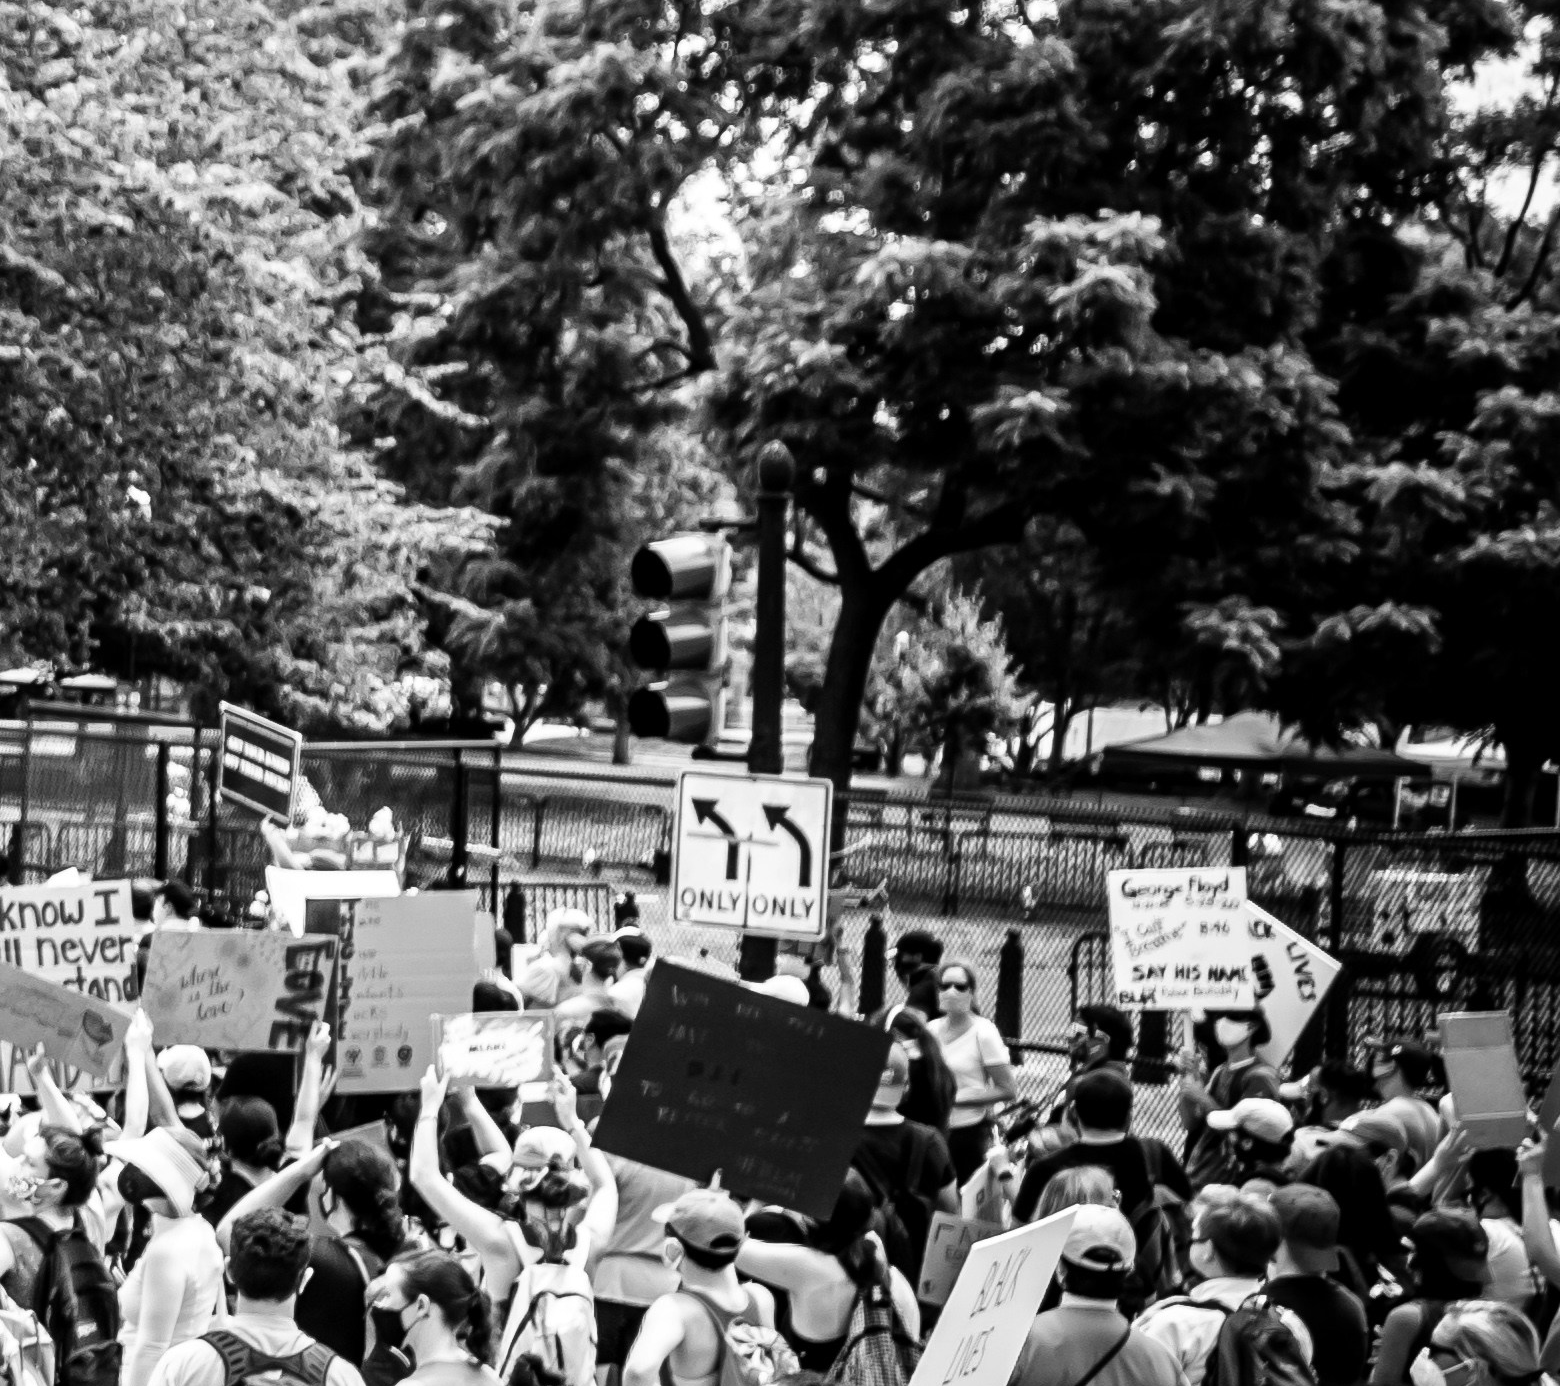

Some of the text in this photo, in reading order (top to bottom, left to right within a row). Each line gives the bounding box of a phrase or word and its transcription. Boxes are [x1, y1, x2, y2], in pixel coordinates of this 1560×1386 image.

[681, 887, 741, 912] ONLY
[1121, 871, 1230, 904] George Floyd
[94, 889, 120, 927] I
[752, 893, 815, 918] ONLY
[36, 934, 132, 967] never
[1132, 963, 1249, 983] SAY HIS NAME
[1286, 941, 1318, 1003] LIVES
[970, 1246, 1033, 1319] BLACK
[942, 1326, 996, 1386] LIVES
